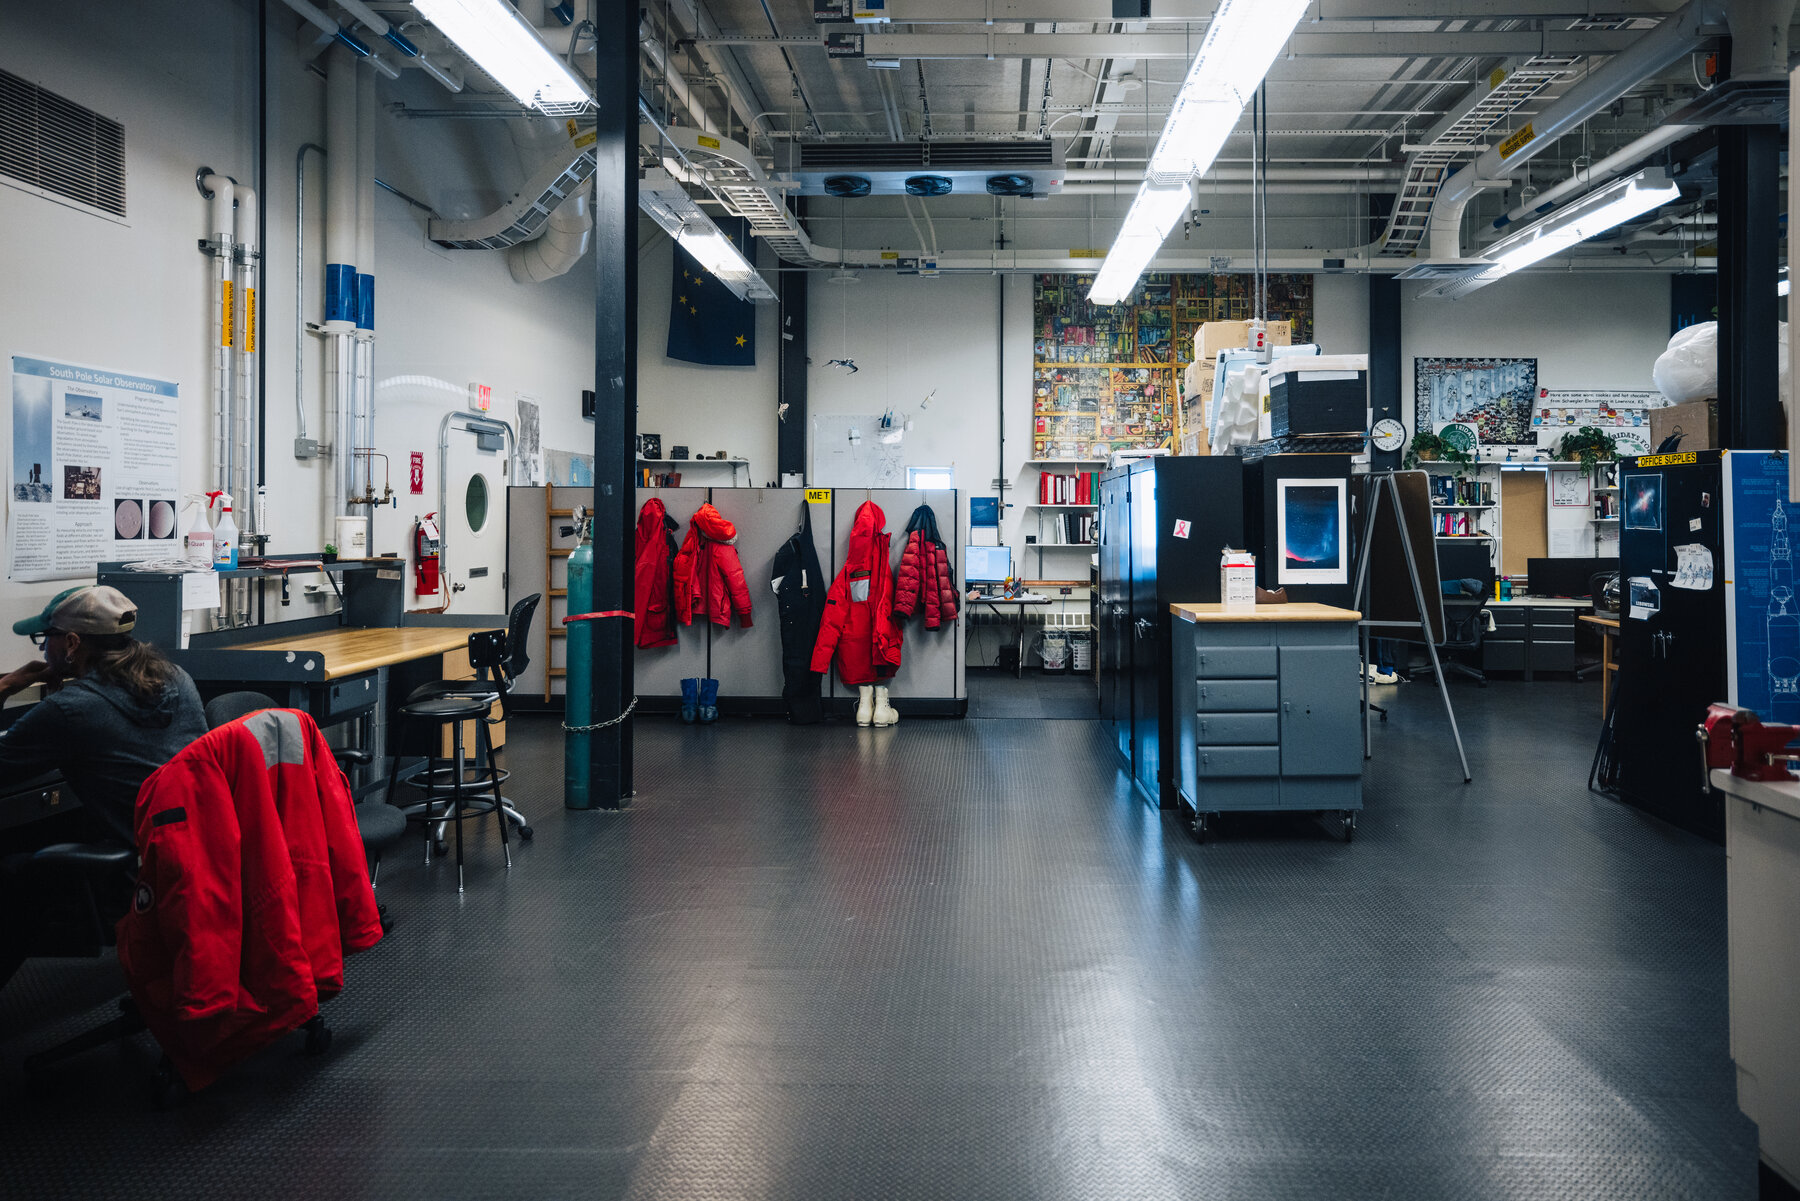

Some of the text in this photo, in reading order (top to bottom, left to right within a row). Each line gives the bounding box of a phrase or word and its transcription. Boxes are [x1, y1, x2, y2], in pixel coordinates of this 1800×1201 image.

[50, 366, 157, 394] South Pole Solar Observatory
[478, 384, 491, 409] EXIT
[1455, 424, 1476, 443] FRIDAYS
[1611, 432, 1640, 441] RIDAYS
[1640, 452, 1696, 466] OFFICE SUPPLIES
[809, 491, 830, 500] MET
